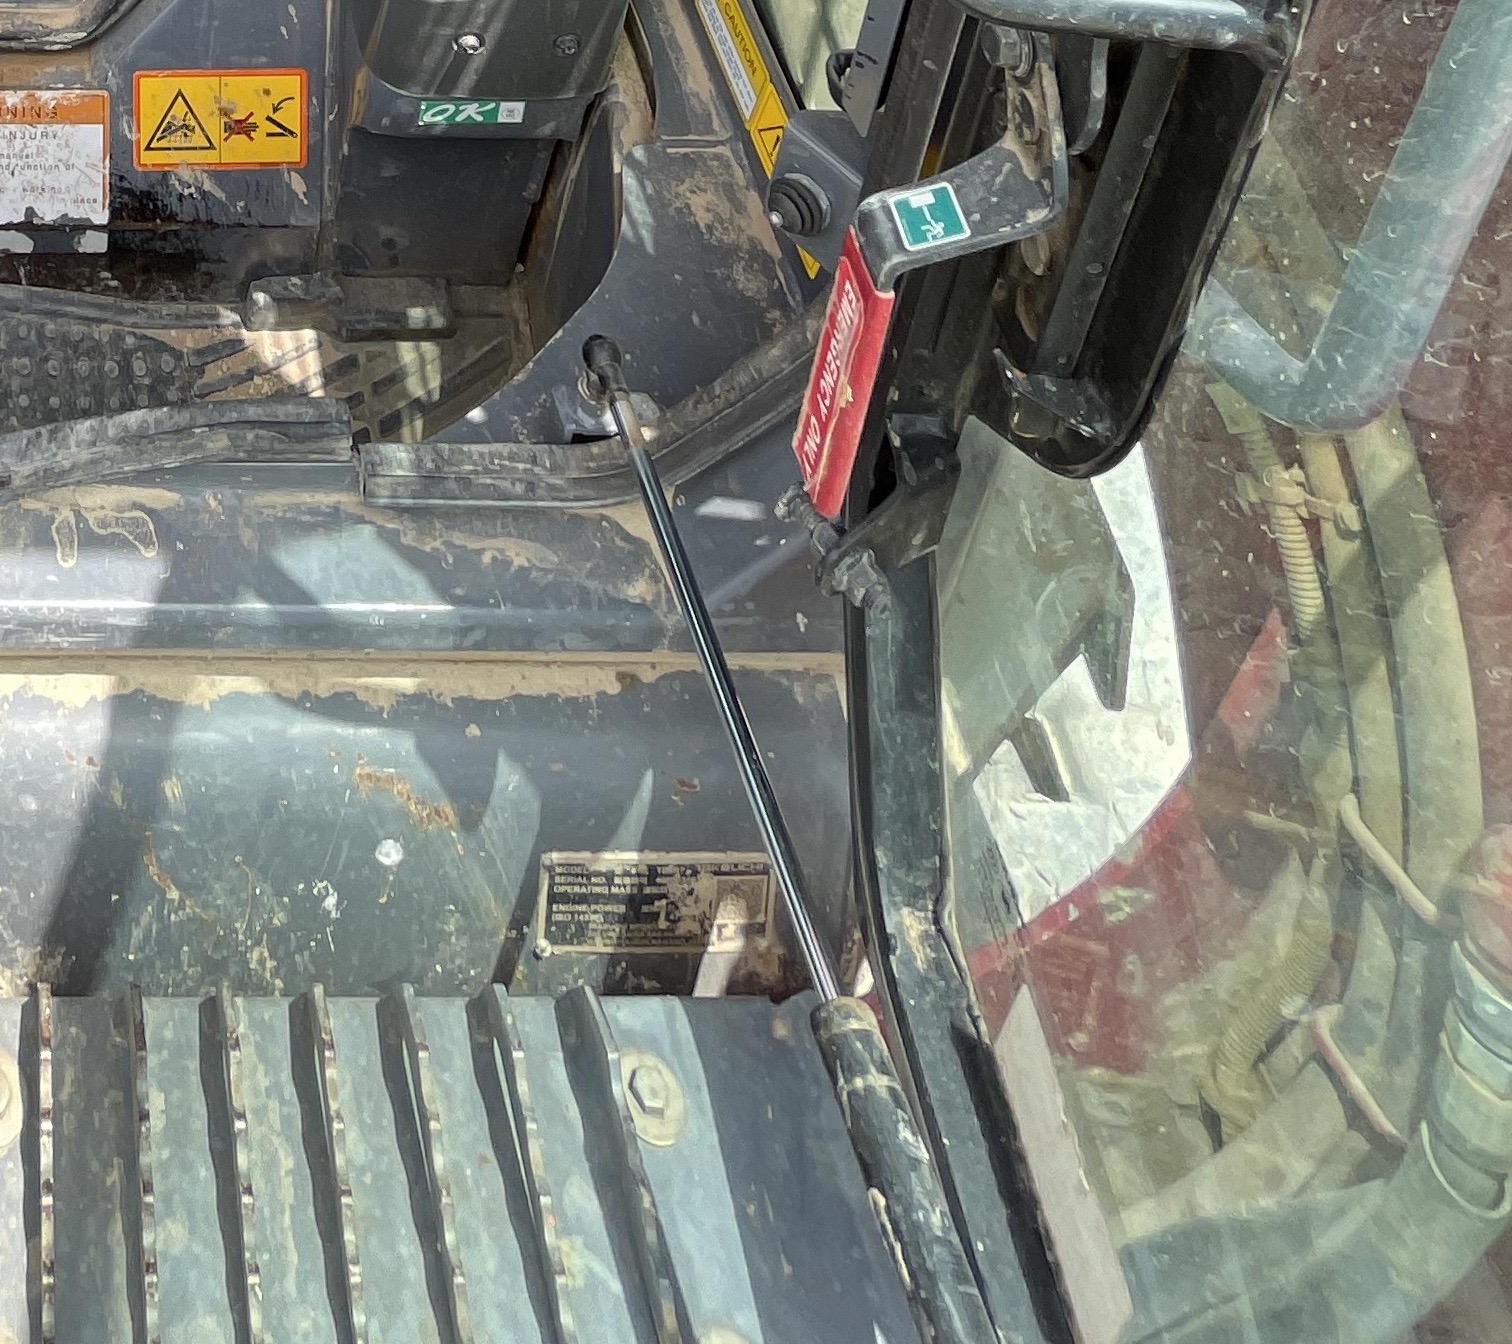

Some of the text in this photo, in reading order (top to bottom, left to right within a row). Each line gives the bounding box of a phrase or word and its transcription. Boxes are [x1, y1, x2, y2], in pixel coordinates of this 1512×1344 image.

[724, 2, 757, 77] CAUTION
[422, 102, 496, 123] OK
[802, 414, 821, 481] ONLY
